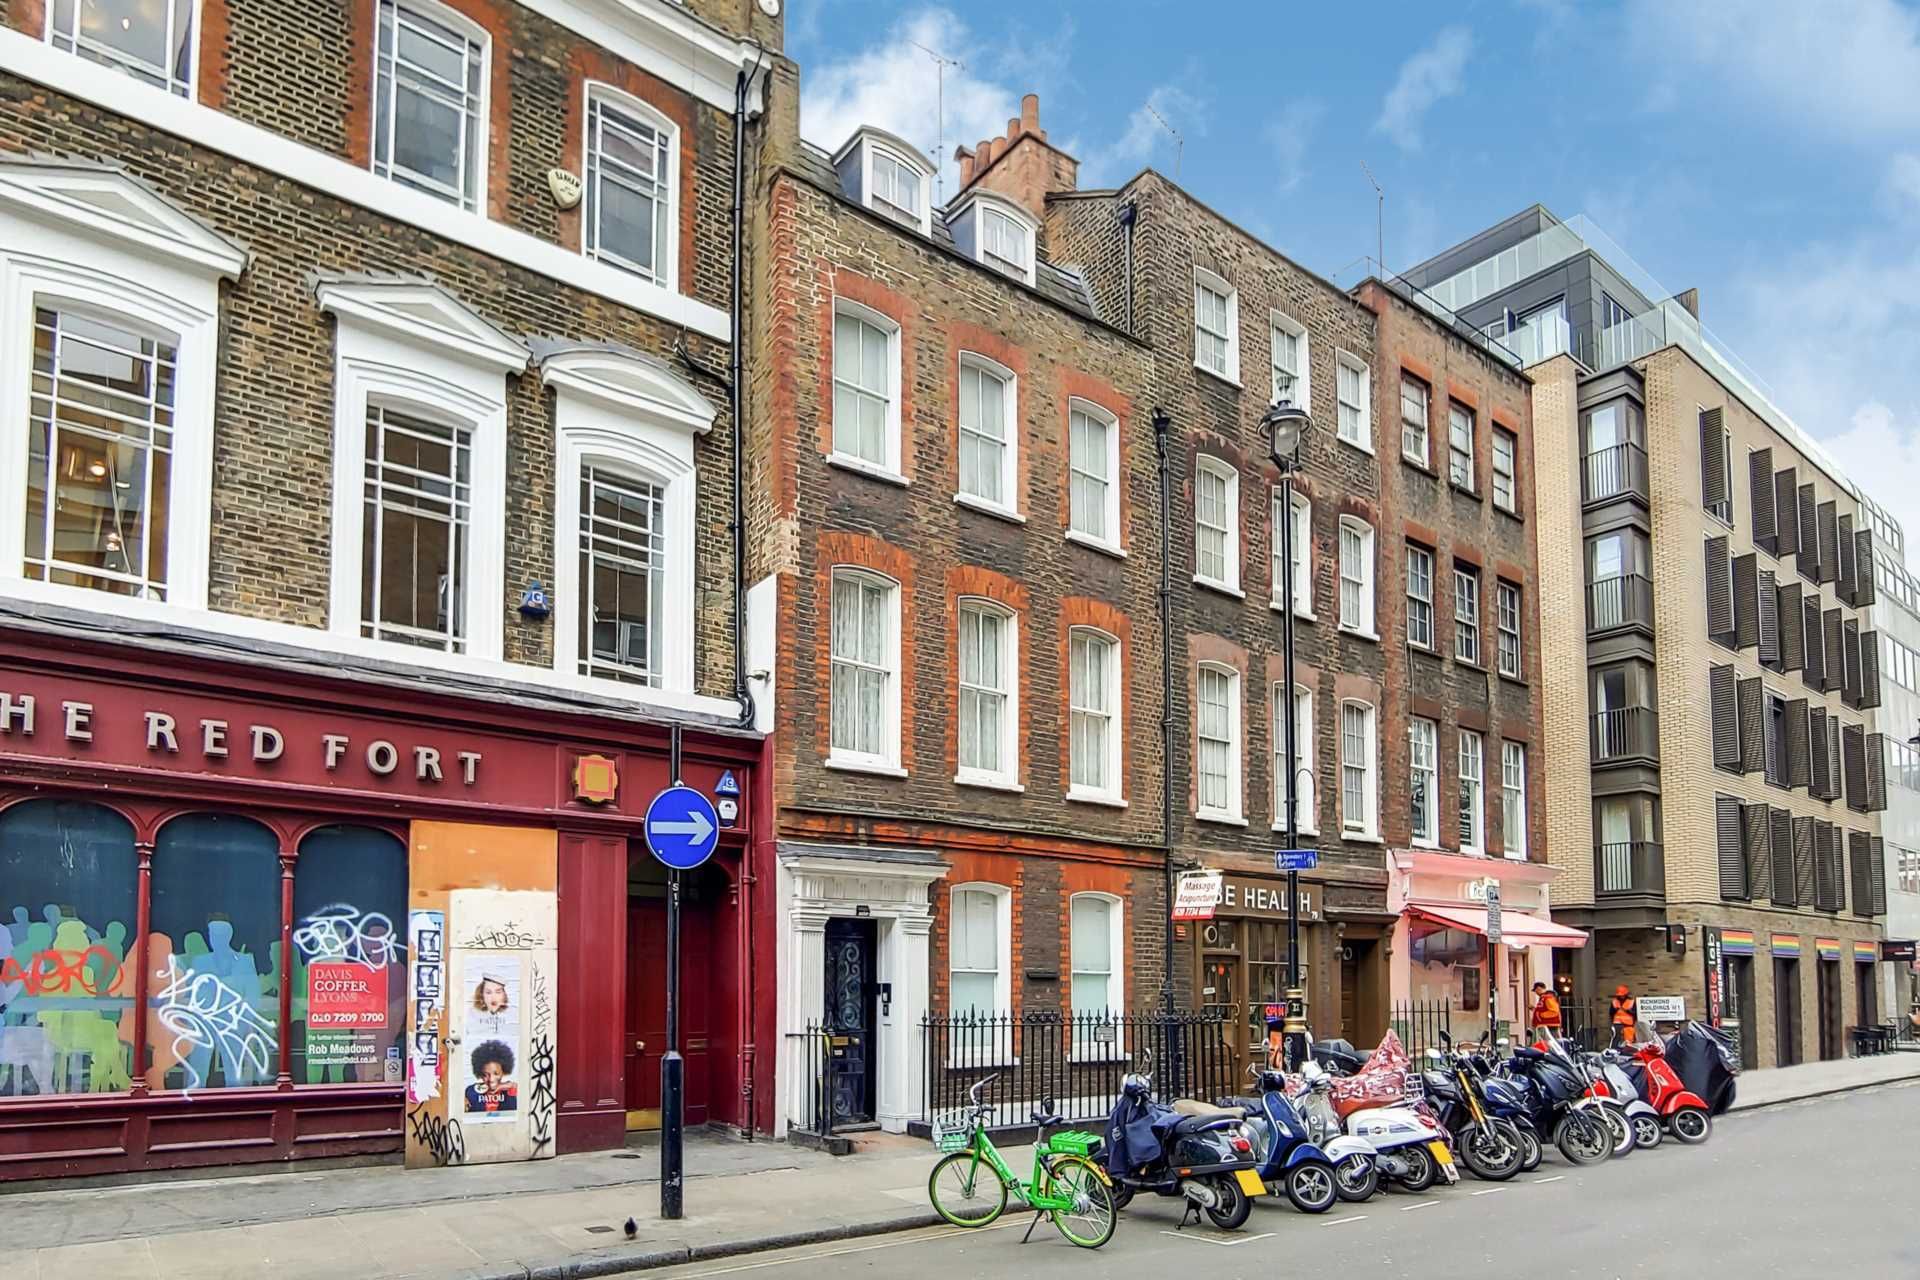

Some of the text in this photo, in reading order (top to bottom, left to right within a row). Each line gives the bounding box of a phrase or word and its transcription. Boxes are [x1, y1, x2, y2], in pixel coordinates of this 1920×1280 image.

[0, 692, 483, 785] HE RED FORT
[1184, 882, 1216, 892] Massage
[1244, 887, 1311, 913] HEALH
[1707, 933, 1716, 965] lab
[314, 968, 353, 980] DAVIS
[314, 980, 372, 993] COFFER
[314, 991, 359, 1003] LYONS
[311, 1012, 385, 1023] 020 7209 0700
[308, 1043, 376, 1055] Rob Meadows
[478, 1094, 505, 1104] PATOU
